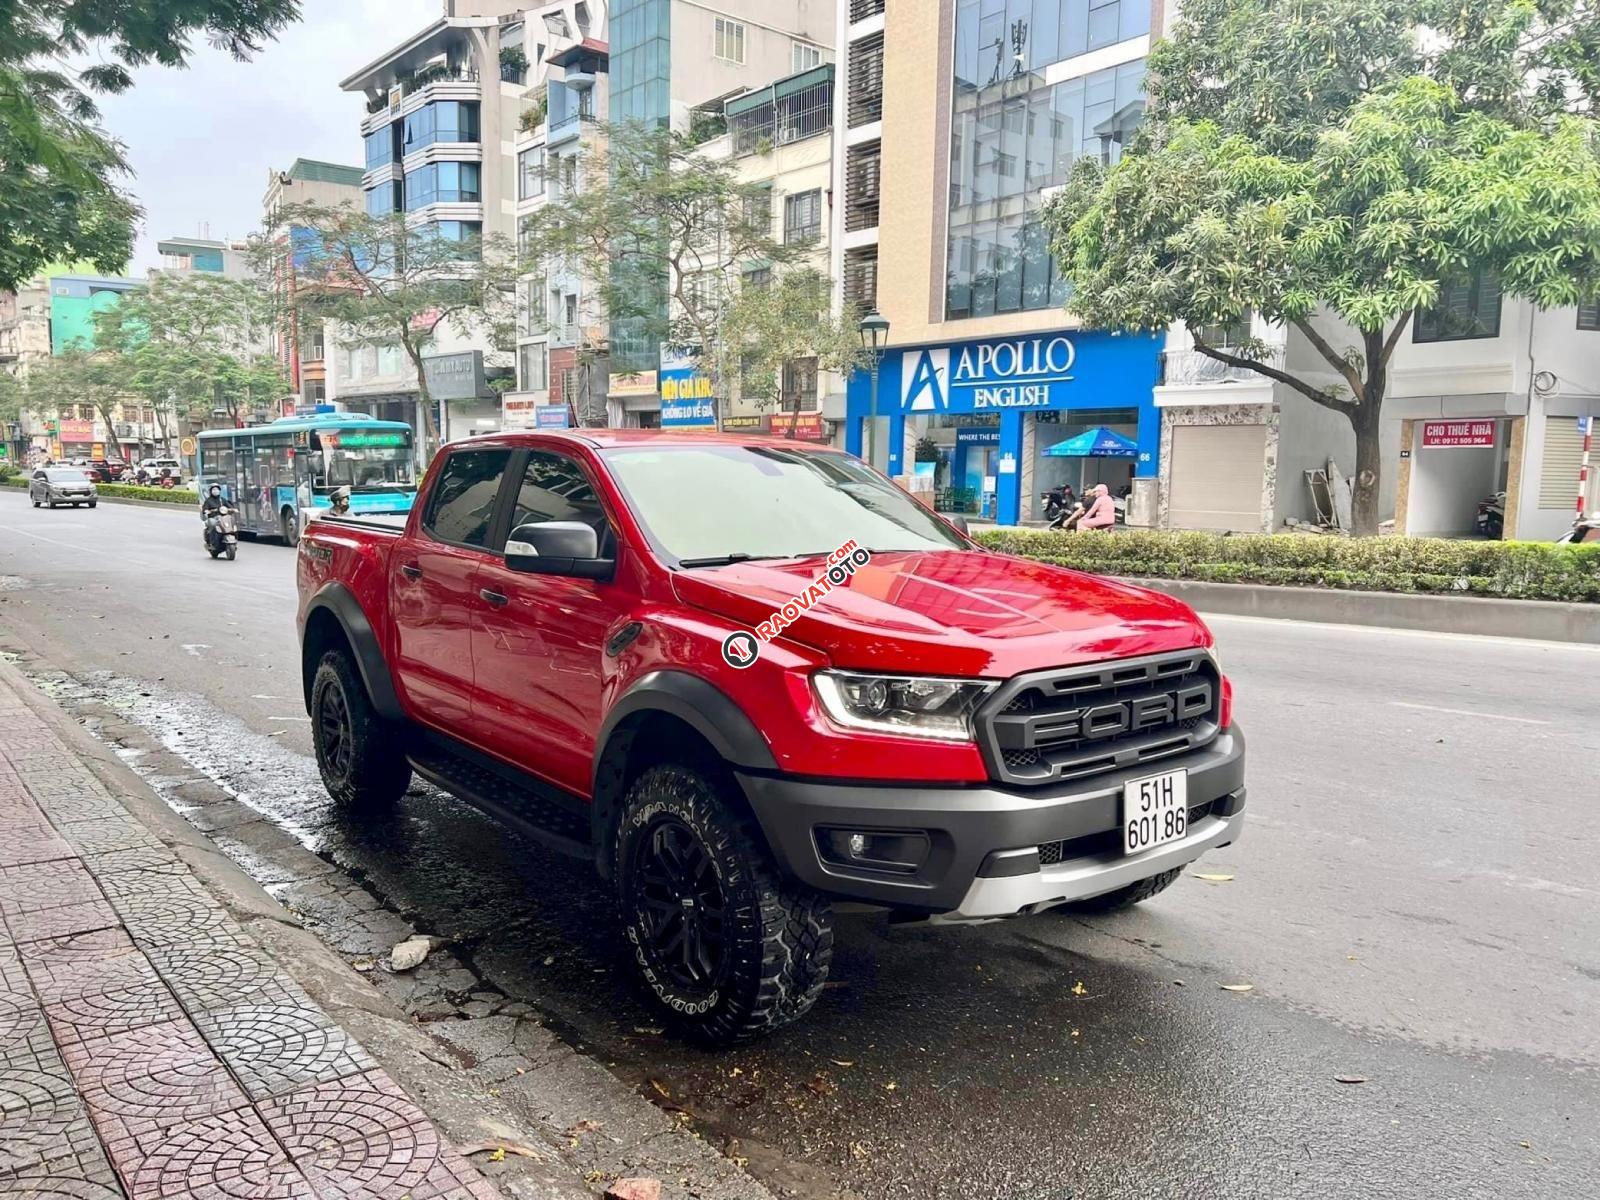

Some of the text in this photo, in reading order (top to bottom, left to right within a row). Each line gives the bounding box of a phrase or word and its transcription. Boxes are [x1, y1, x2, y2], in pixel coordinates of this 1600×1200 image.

[954, 337, 1076, 380] APOLLO
[973, 385, 1051, 409] ENGLISH
[958, 433, 978, 441] WHERE
[1426, 422, 1492, 436] CHO THUÊ NHÀ
[1442, 437, 1458, 445] 0912
[1140, 452, 1151, 462] 66
[1023, 683, 1213, 750] FORD
[1139, 776, 1174, 813] 51H
[1127, 806, 1186, 850] 601.86
